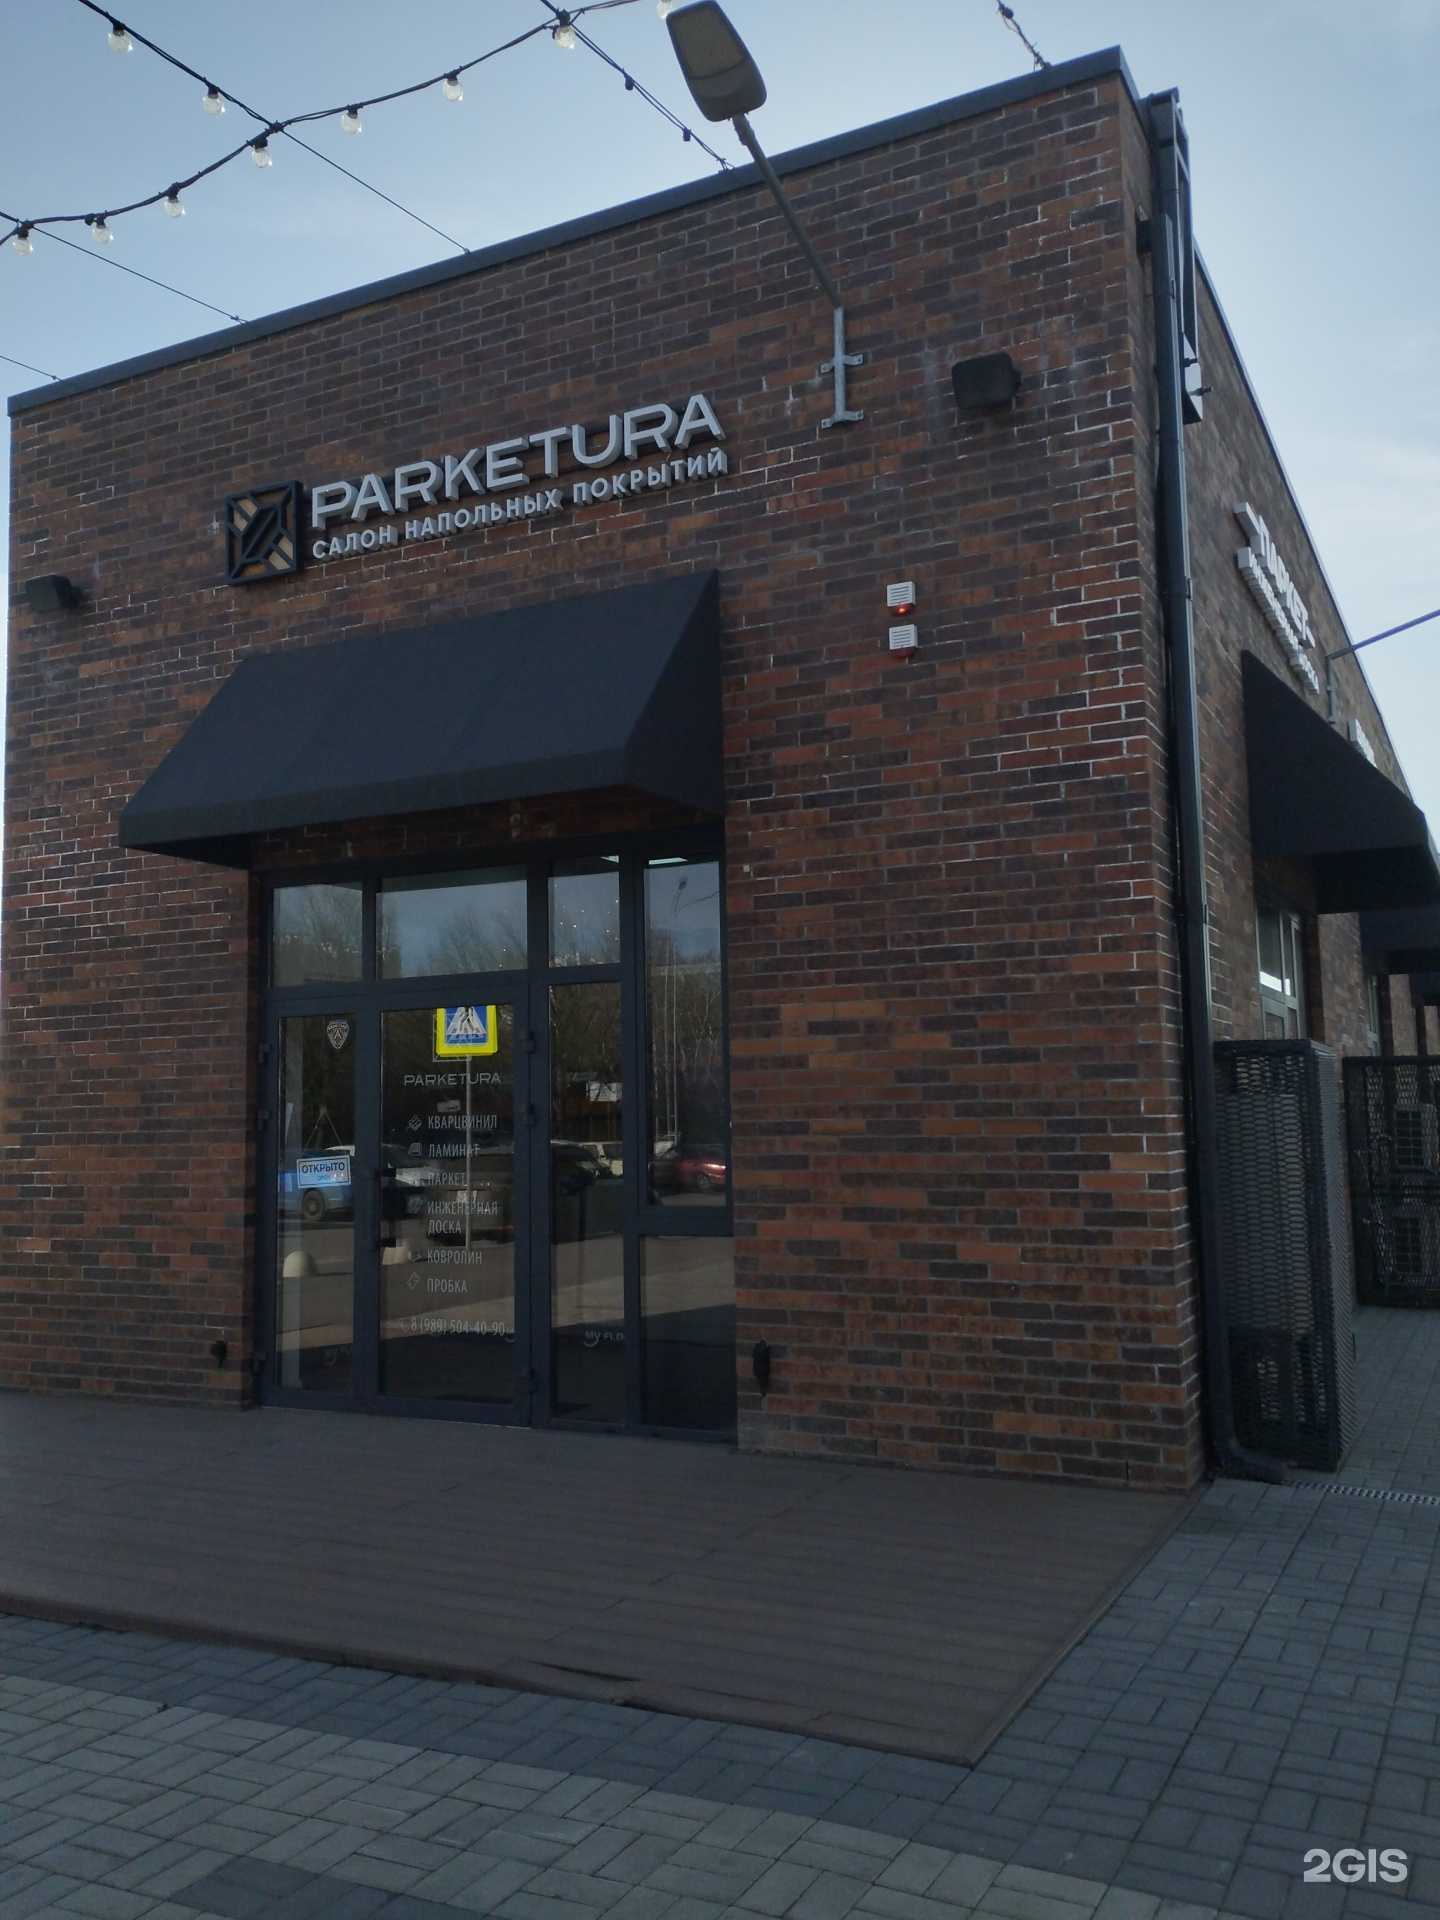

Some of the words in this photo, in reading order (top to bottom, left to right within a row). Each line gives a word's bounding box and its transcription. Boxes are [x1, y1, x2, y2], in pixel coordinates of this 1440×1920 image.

[311, 393, 727, 529] PARKETURA
[312, 524, 398, 561] САЛОН
[404, 490, 563, 542] НАПОЛЬНЫХ
[572, 447, 728, 506] ПОКРЫТИЙ
[403, 1072, 502, 1087] PARKETURA
[427, 1114, 498, 1129] КВАРЦВИНИЛ
[301, 1161, 346, 1174] ОТКРЫТО
[427, 1219, 462, 1235] ДОСКА
[426, 1248, 483, 1265] КОВРОЛИН
[426, 1278, 469, 1294] ПРОБКА
